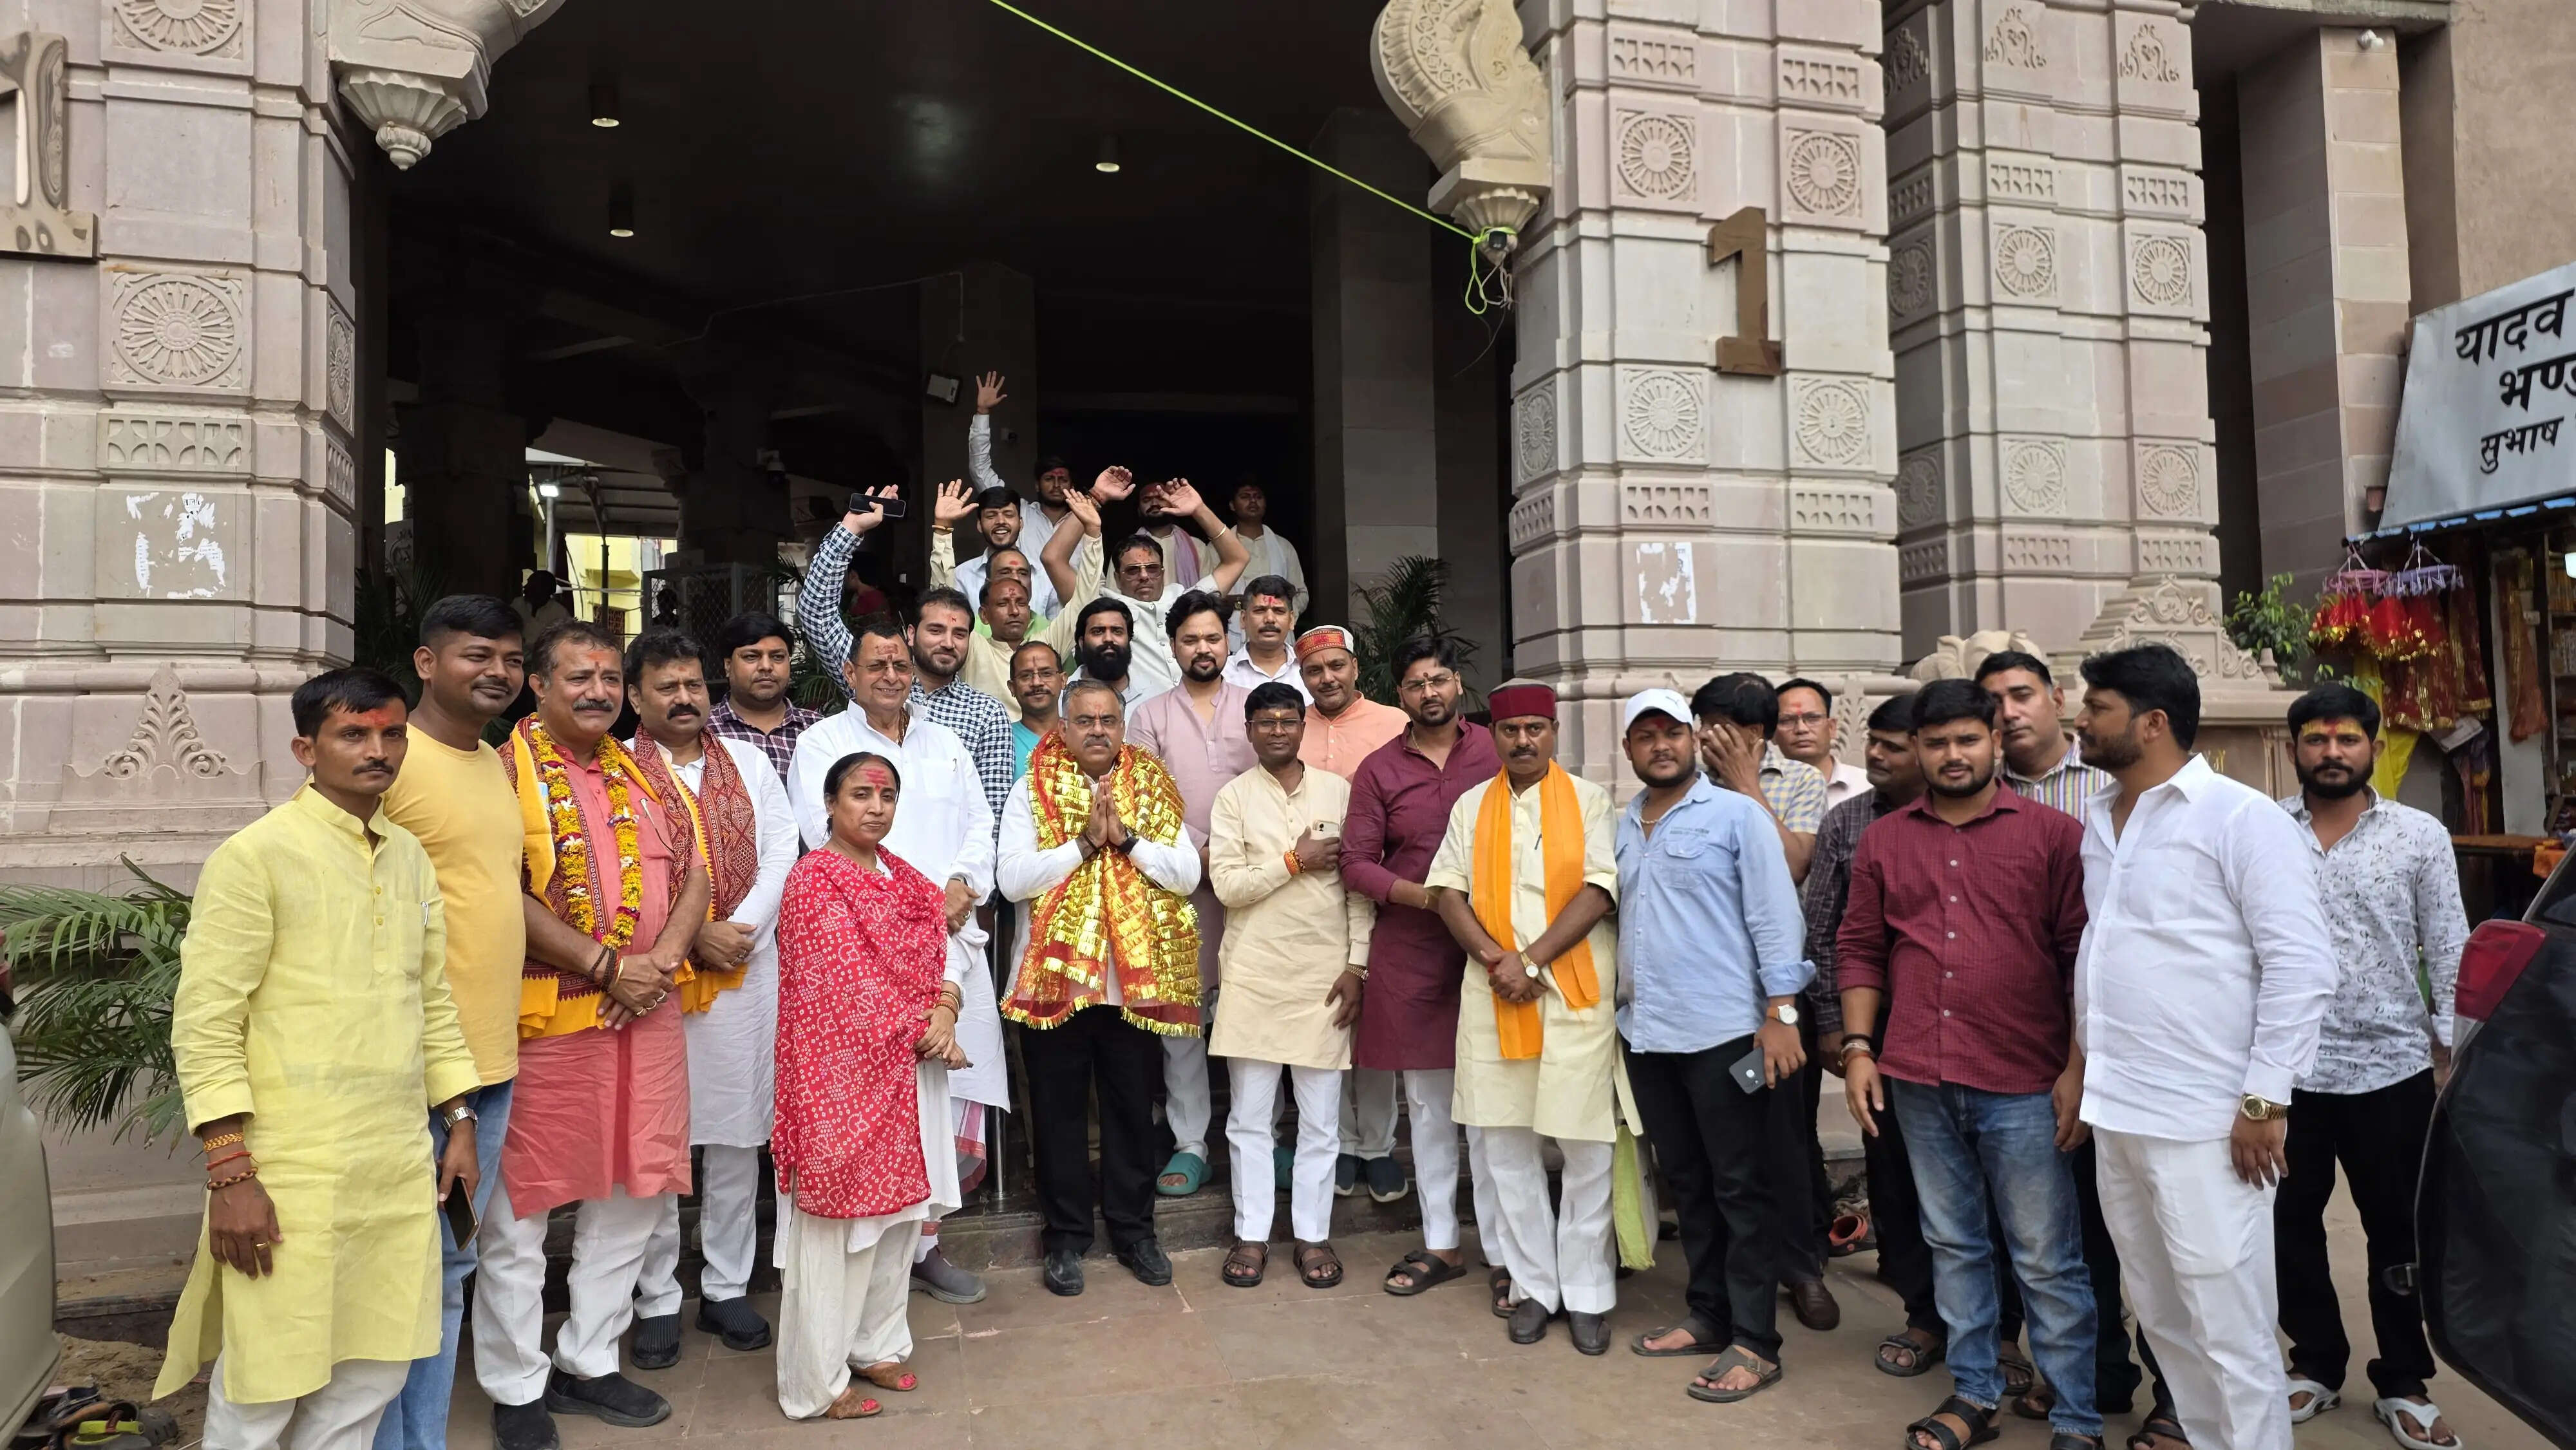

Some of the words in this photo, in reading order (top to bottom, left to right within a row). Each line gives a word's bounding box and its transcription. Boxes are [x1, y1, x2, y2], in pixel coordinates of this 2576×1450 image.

[1707, 206, 1782, 375] 1
[2455, 287, 2575, 366] यादव
[2480, 416, 2564, 475] सुभाष
